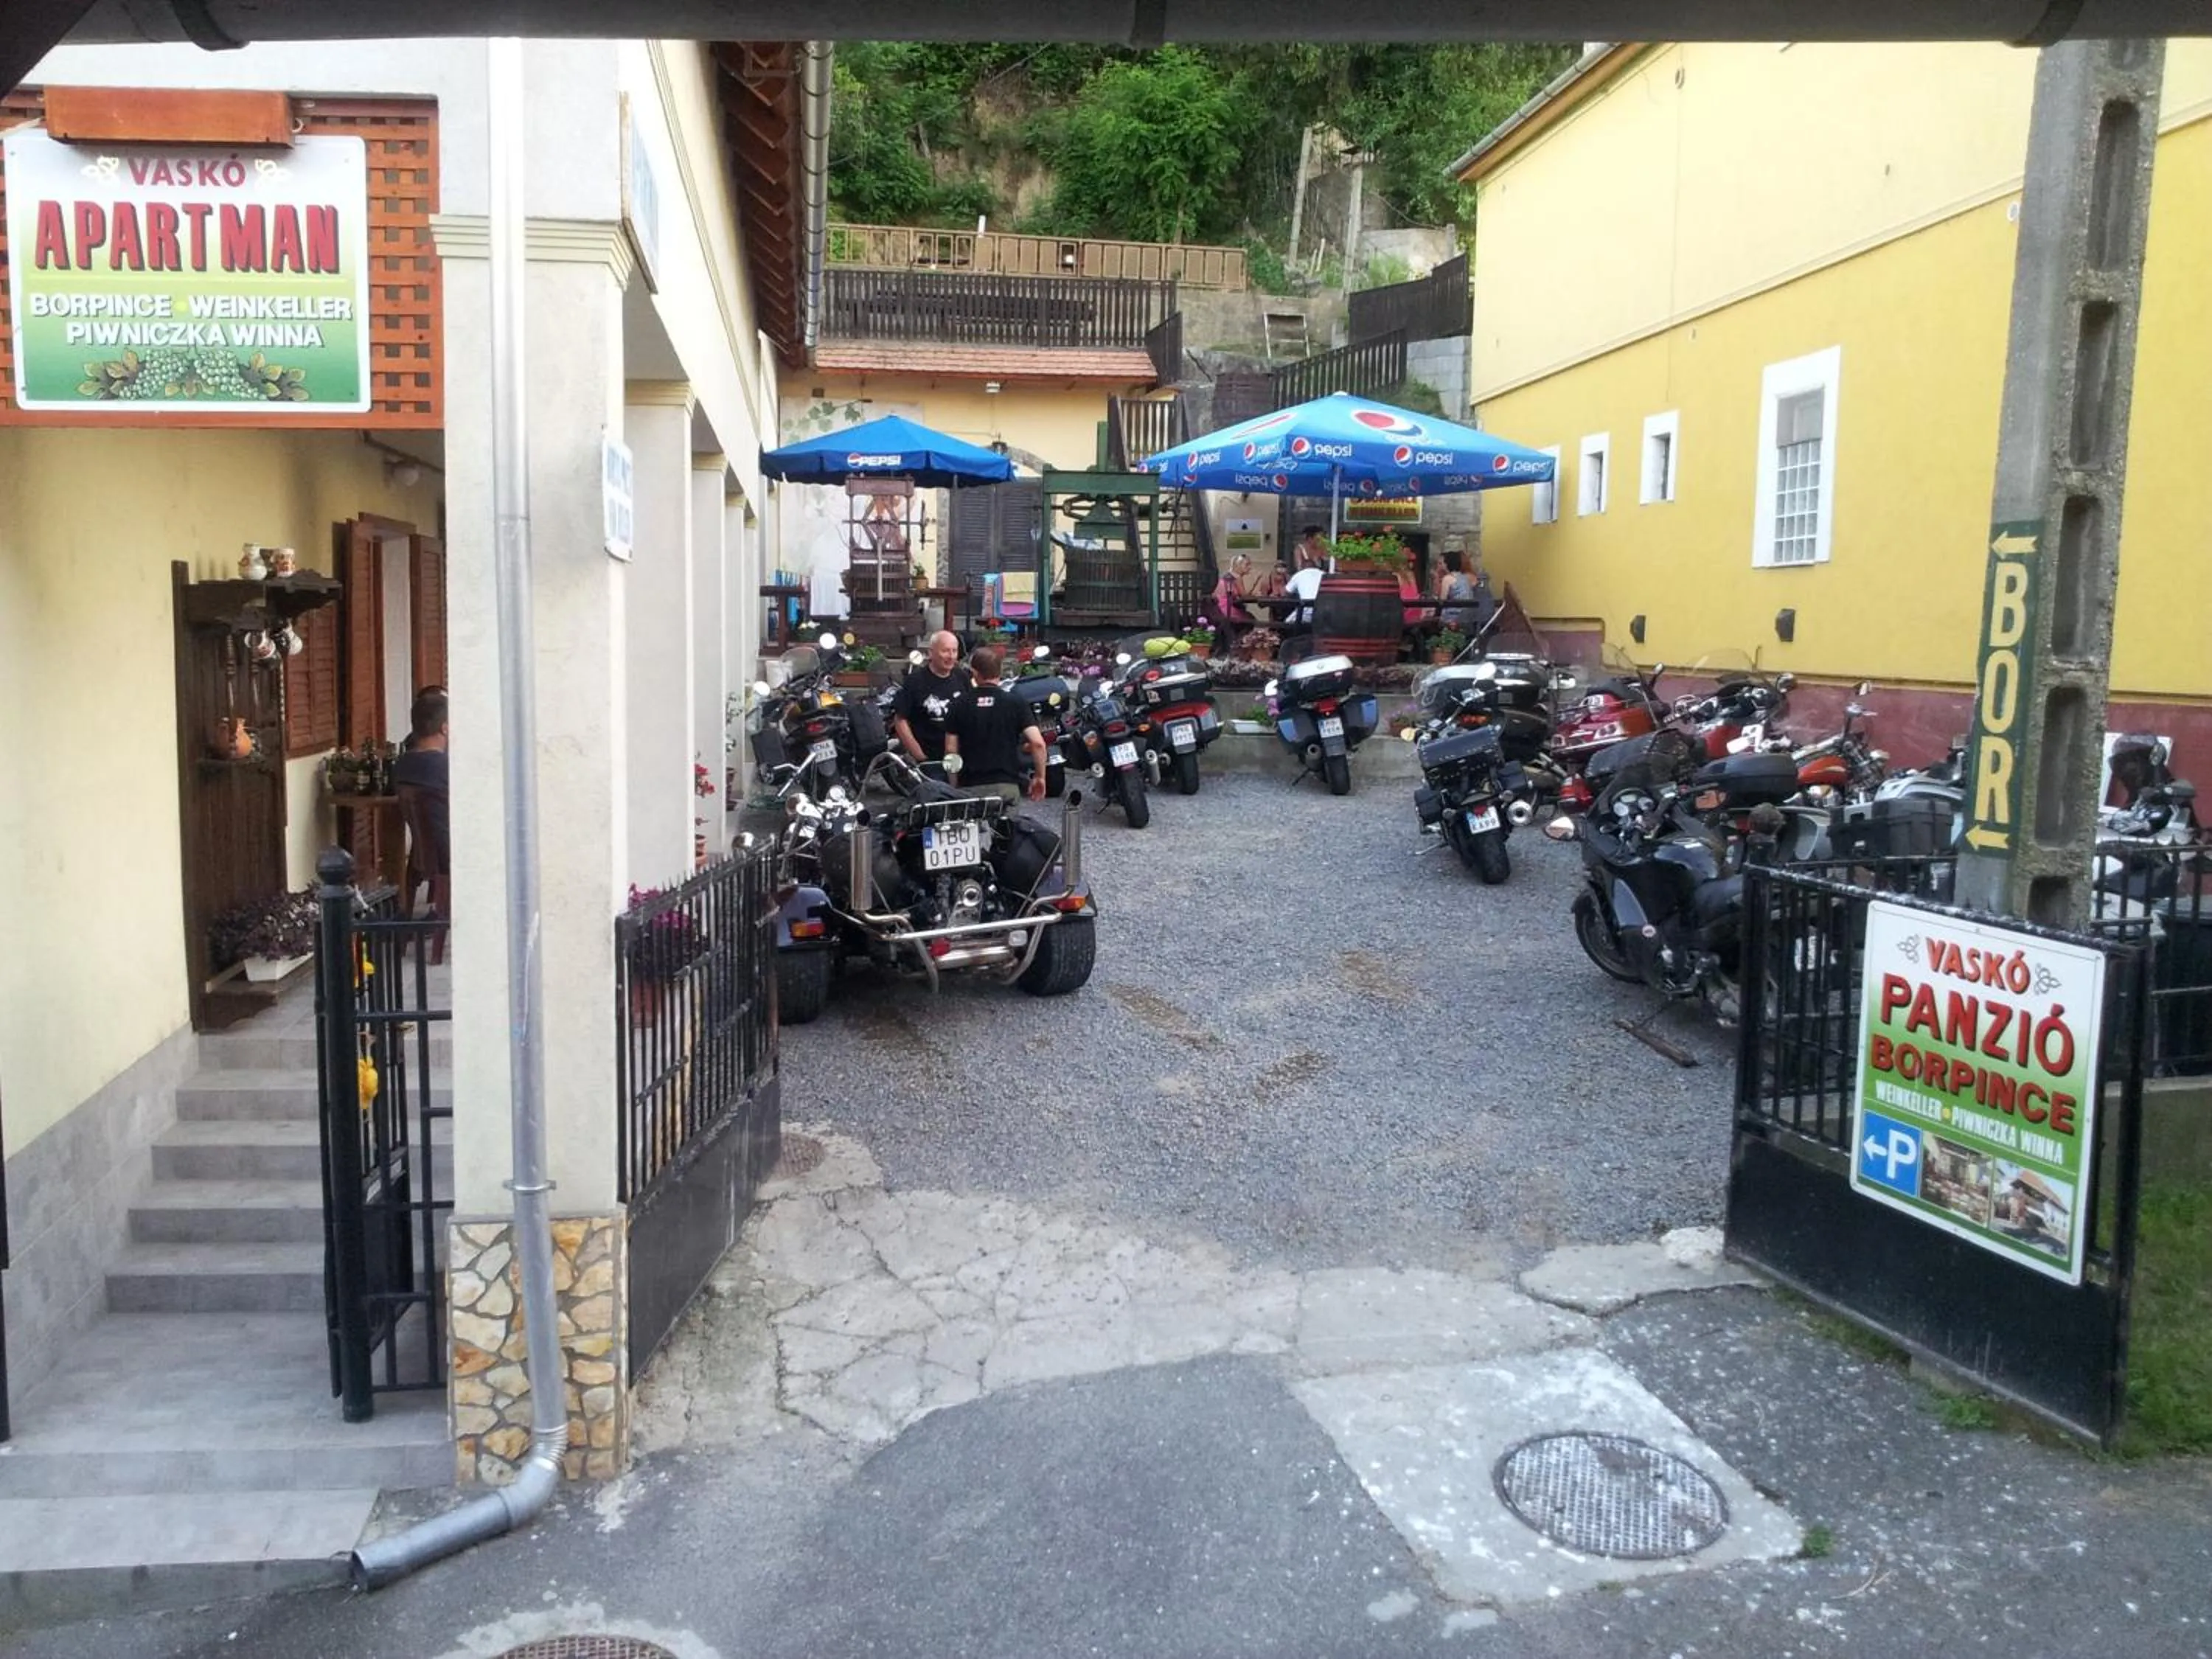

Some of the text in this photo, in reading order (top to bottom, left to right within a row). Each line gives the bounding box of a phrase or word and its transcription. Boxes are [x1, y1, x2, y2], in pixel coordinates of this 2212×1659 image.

[128, 153, 247, 188] VASKÓ
[35, 200, 341, 274] APARTMAN
[30, 293, 353, 321] BORPINCE WEINKELLER
[66, 322, 324, 348] PIWNICZKA WINNA
[859, 454, 902, 467] PEPSI
[1198, 450, 1221, 467] pepsi
[1315, 444, 1352, 458] pepsi
[1415, 451, 1453, 466] pepsi
[1974, 561, 2028, 824] BOR
[930, 846, 975, 866] 01PU
[1926, 937, 2031, 995] VASKÓ
[1881, 973, 2075, 1077] PANZIÓ
[1871, 1034, 2078, 1135] BORPINCE
[1875, 1079, 2064, 1165] WEINKELLER PIWNICZKA WINNA
[1886, 1129, 1918, 1179] P
